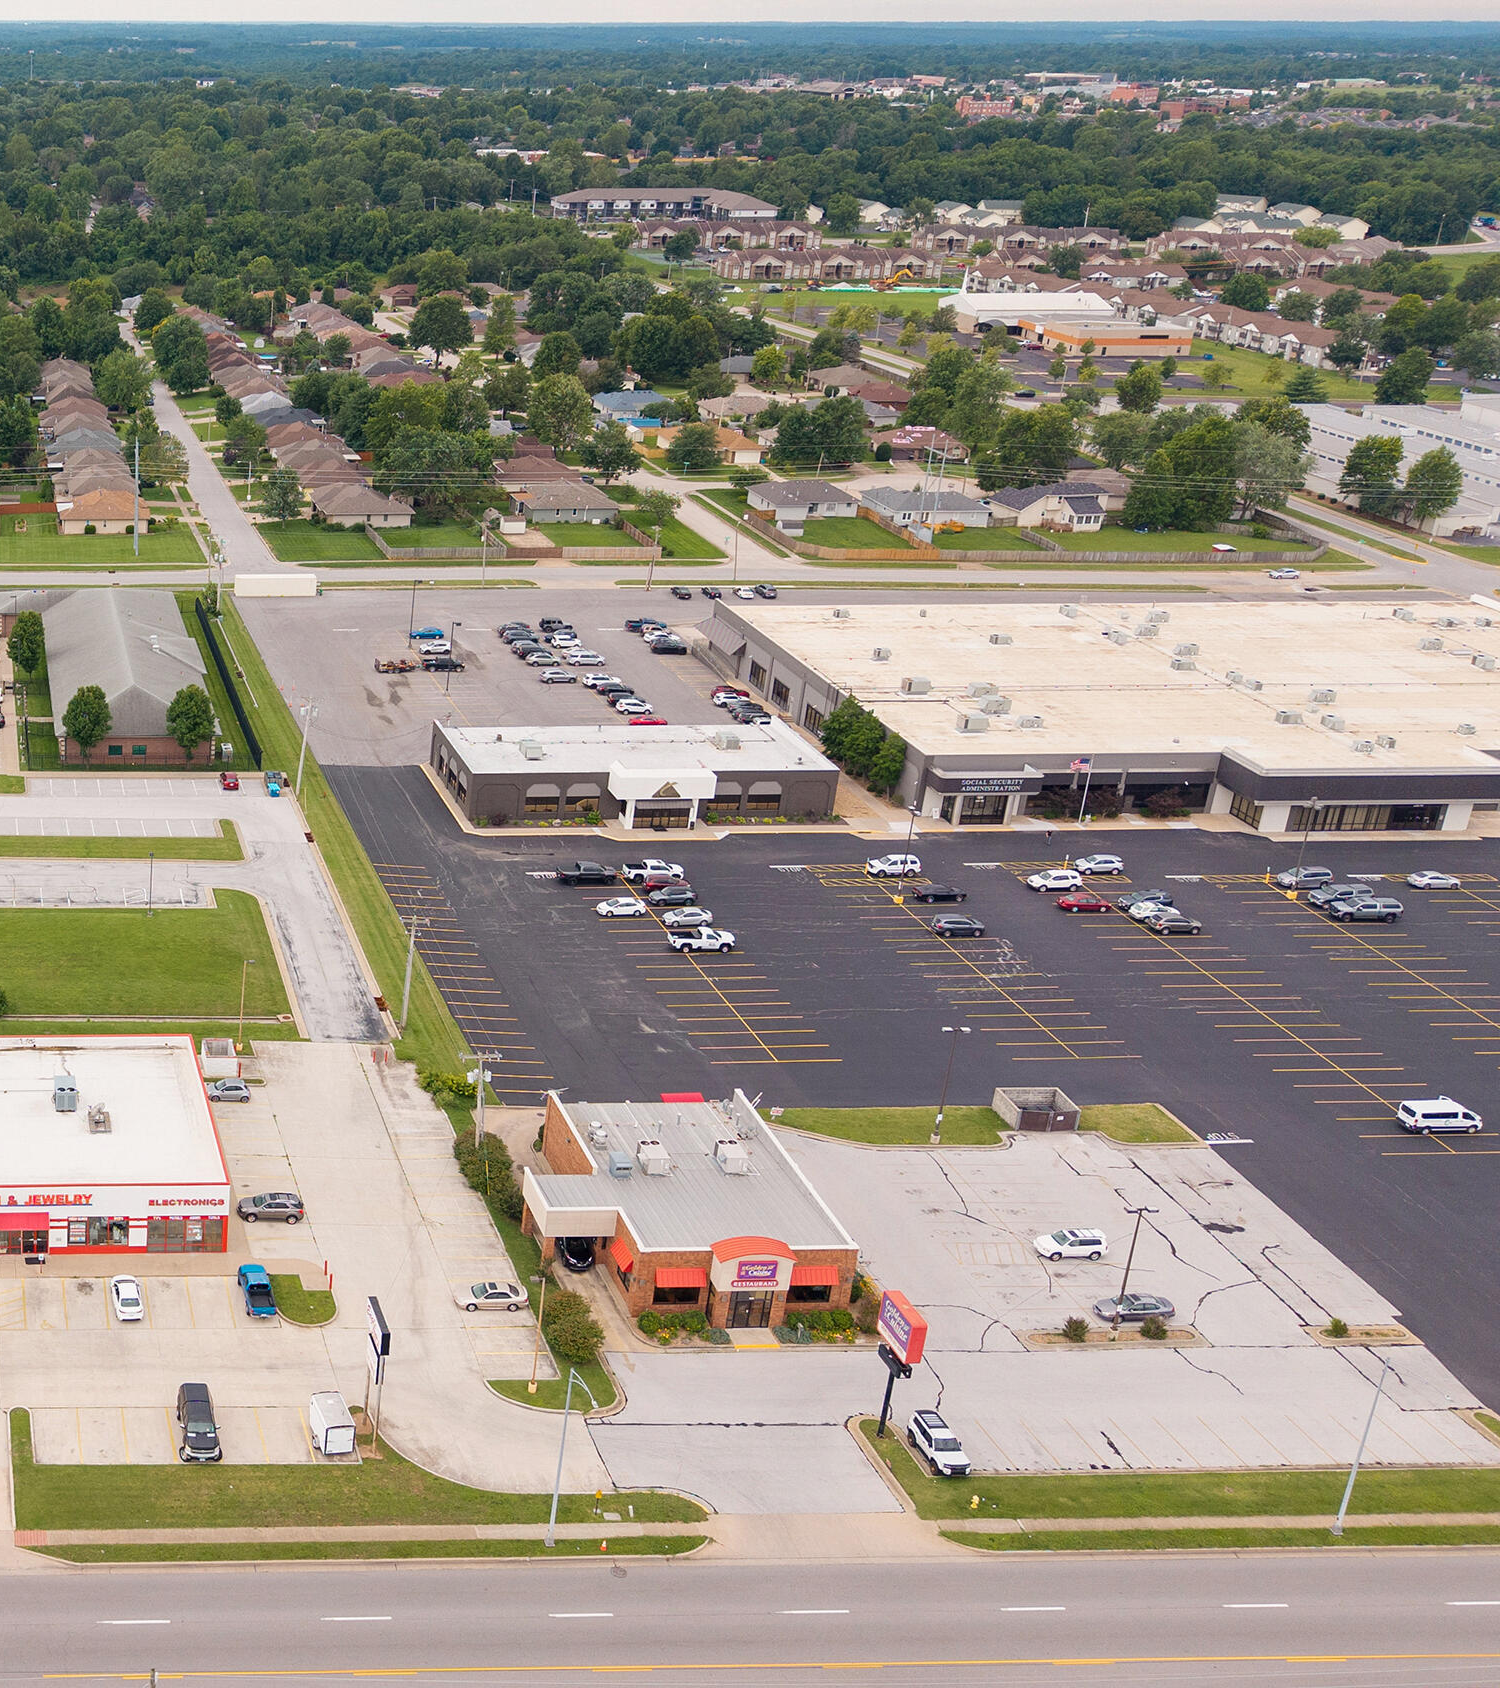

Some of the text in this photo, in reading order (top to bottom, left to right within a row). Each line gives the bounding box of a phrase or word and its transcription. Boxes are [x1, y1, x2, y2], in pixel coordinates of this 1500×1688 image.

[7, 1195, 18, 1206] &
[24, 1194, 93, 1206] JEWELRY
[148, 1199, 225, 1207] ELECTRONICS
[885, 1299, 905, 1327] Golden
